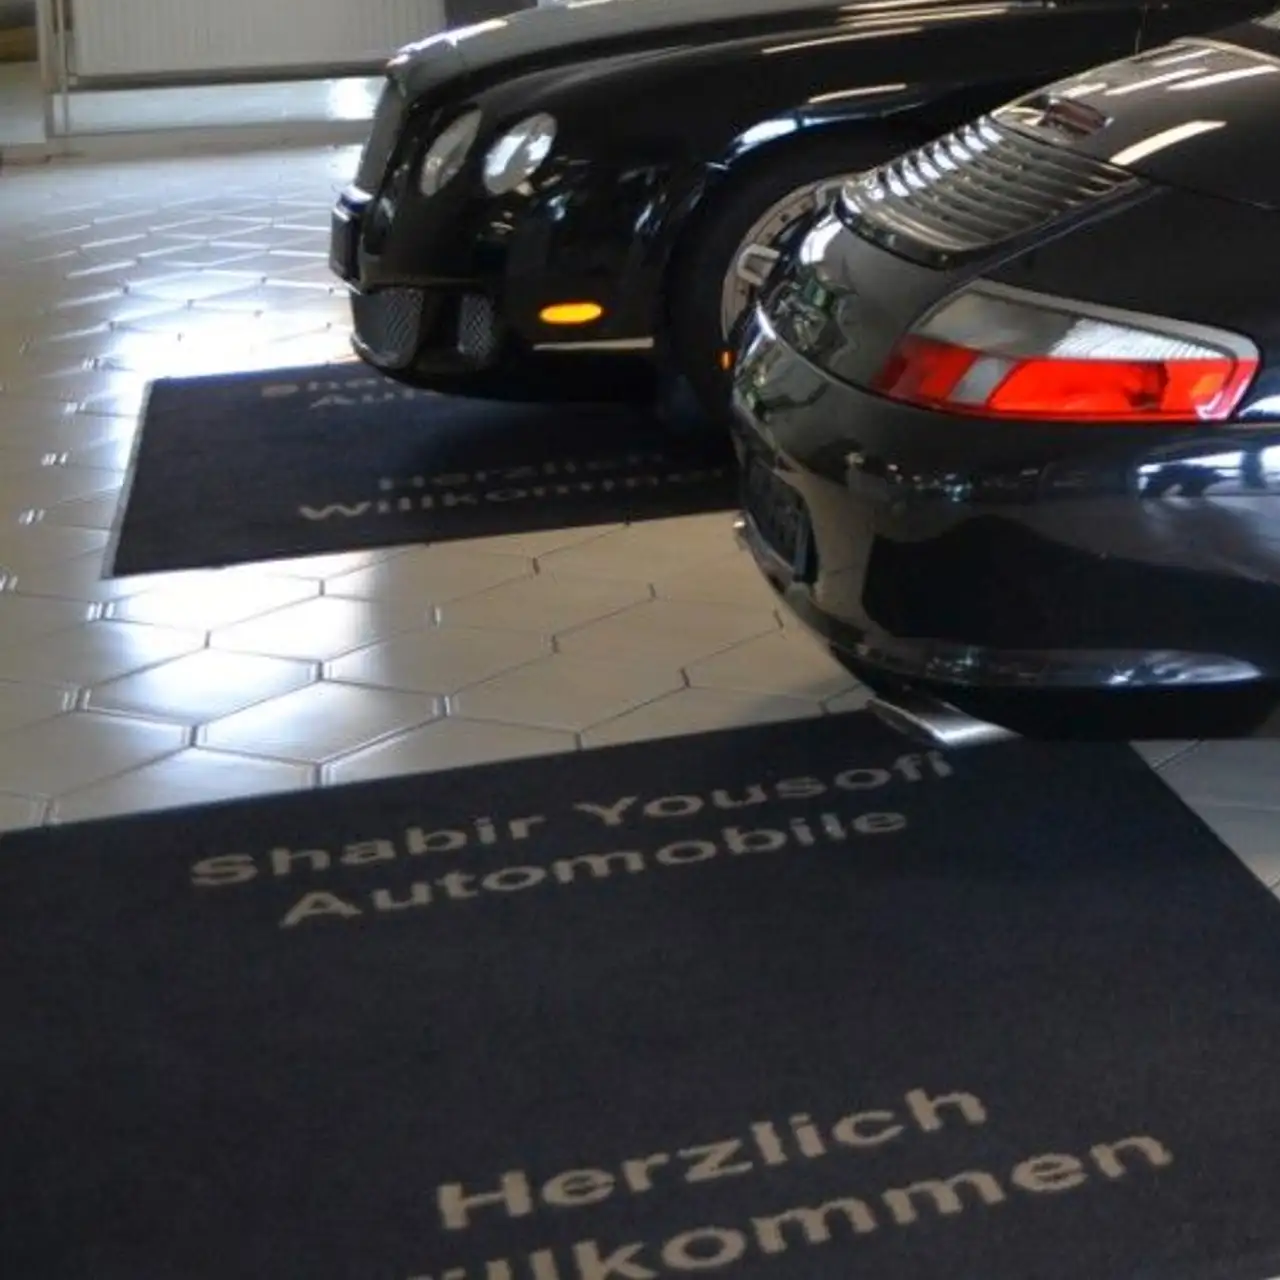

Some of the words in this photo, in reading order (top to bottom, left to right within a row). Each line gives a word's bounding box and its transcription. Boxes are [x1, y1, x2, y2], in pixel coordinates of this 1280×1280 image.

[190, 814, 546, 887] Shabir
[575, 750, 953, 827] Yousofi
[279, 812, 906, 929] Automobile
[437, 1088, 987, 1230] Herzlich
